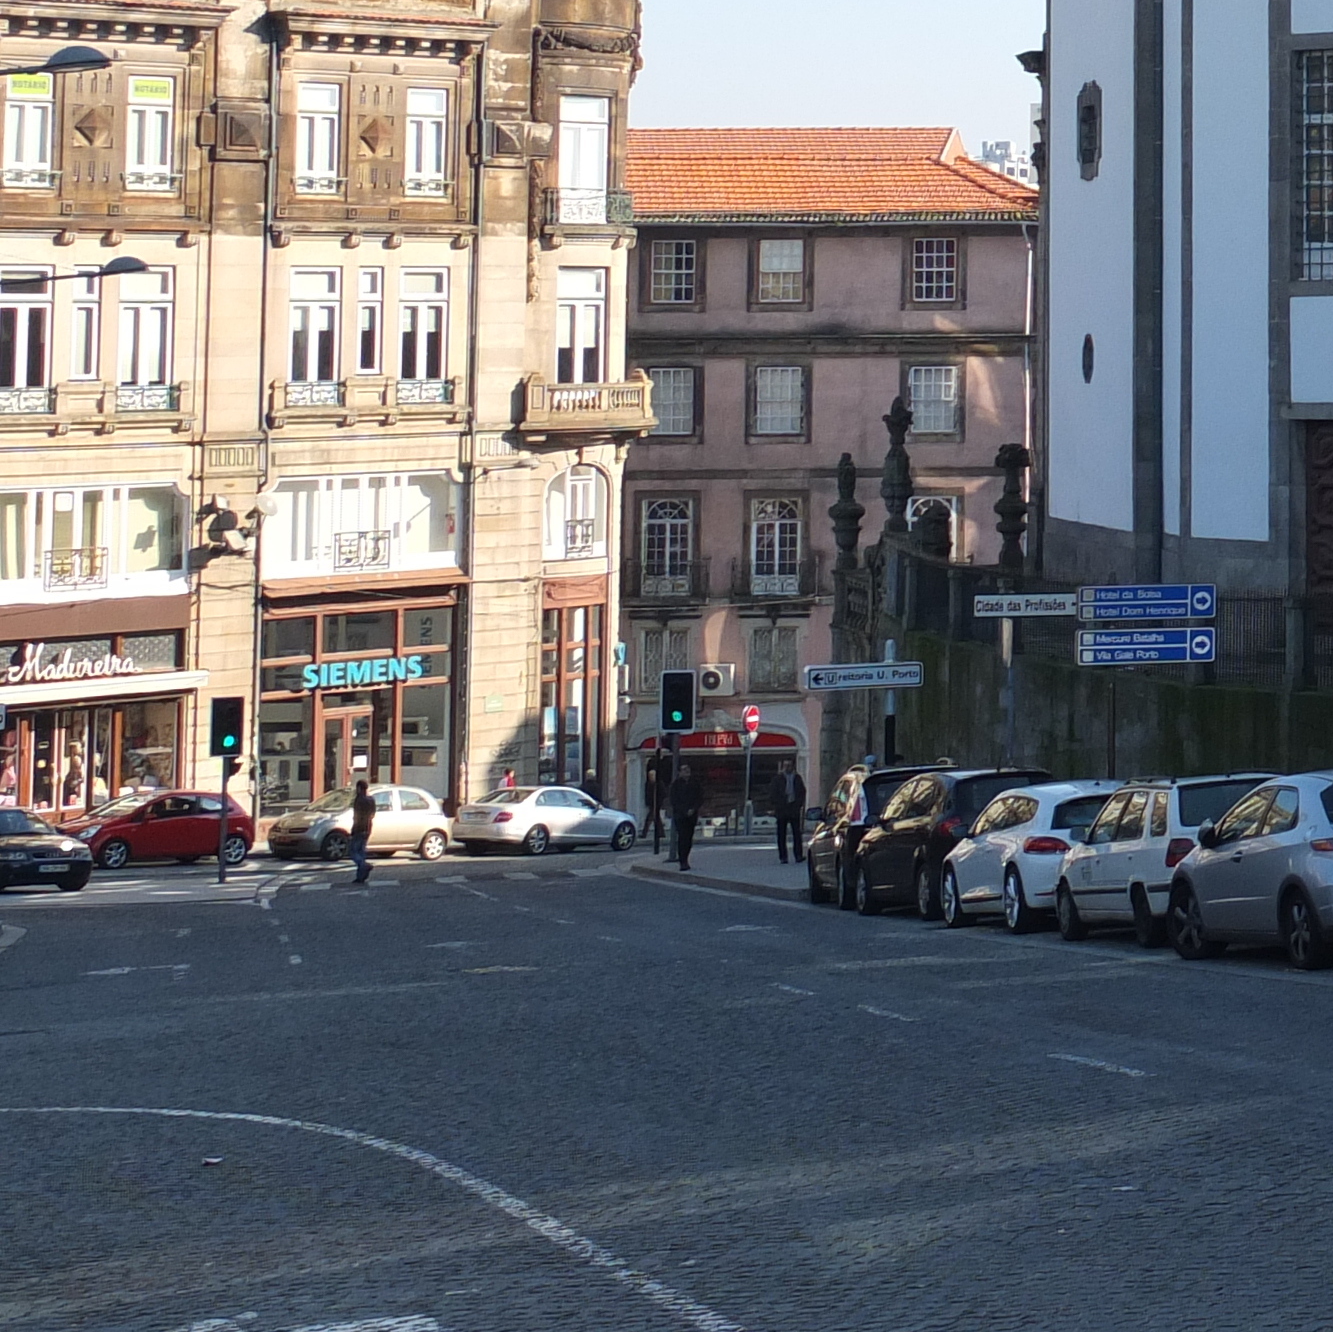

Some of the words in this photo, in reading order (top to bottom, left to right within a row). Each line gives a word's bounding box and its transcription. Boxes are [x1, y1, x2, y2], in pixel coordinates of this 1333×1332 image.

[1096, 589, 1120, 600] Hotel
[1122, 590, 1134, 599] da
[975, 599, 1004, 613] Cidade
[1006, 598, 1021, 611] das
[1025, 596, 1067, 611] Profissões
[1096, 606, 1120, 617] Hotel
[1122, 606, 1144, 616] Dom
[1146, 605, 1186, 617] Henrique
[1136, 650, 1159, 660] Porto
[7, 642, 143, 683] Madureira
[302, 656, 424, 689] SIEMENS
[838, 671, 874, 682] reitoria
[892, 669, 919, 679] Porto
